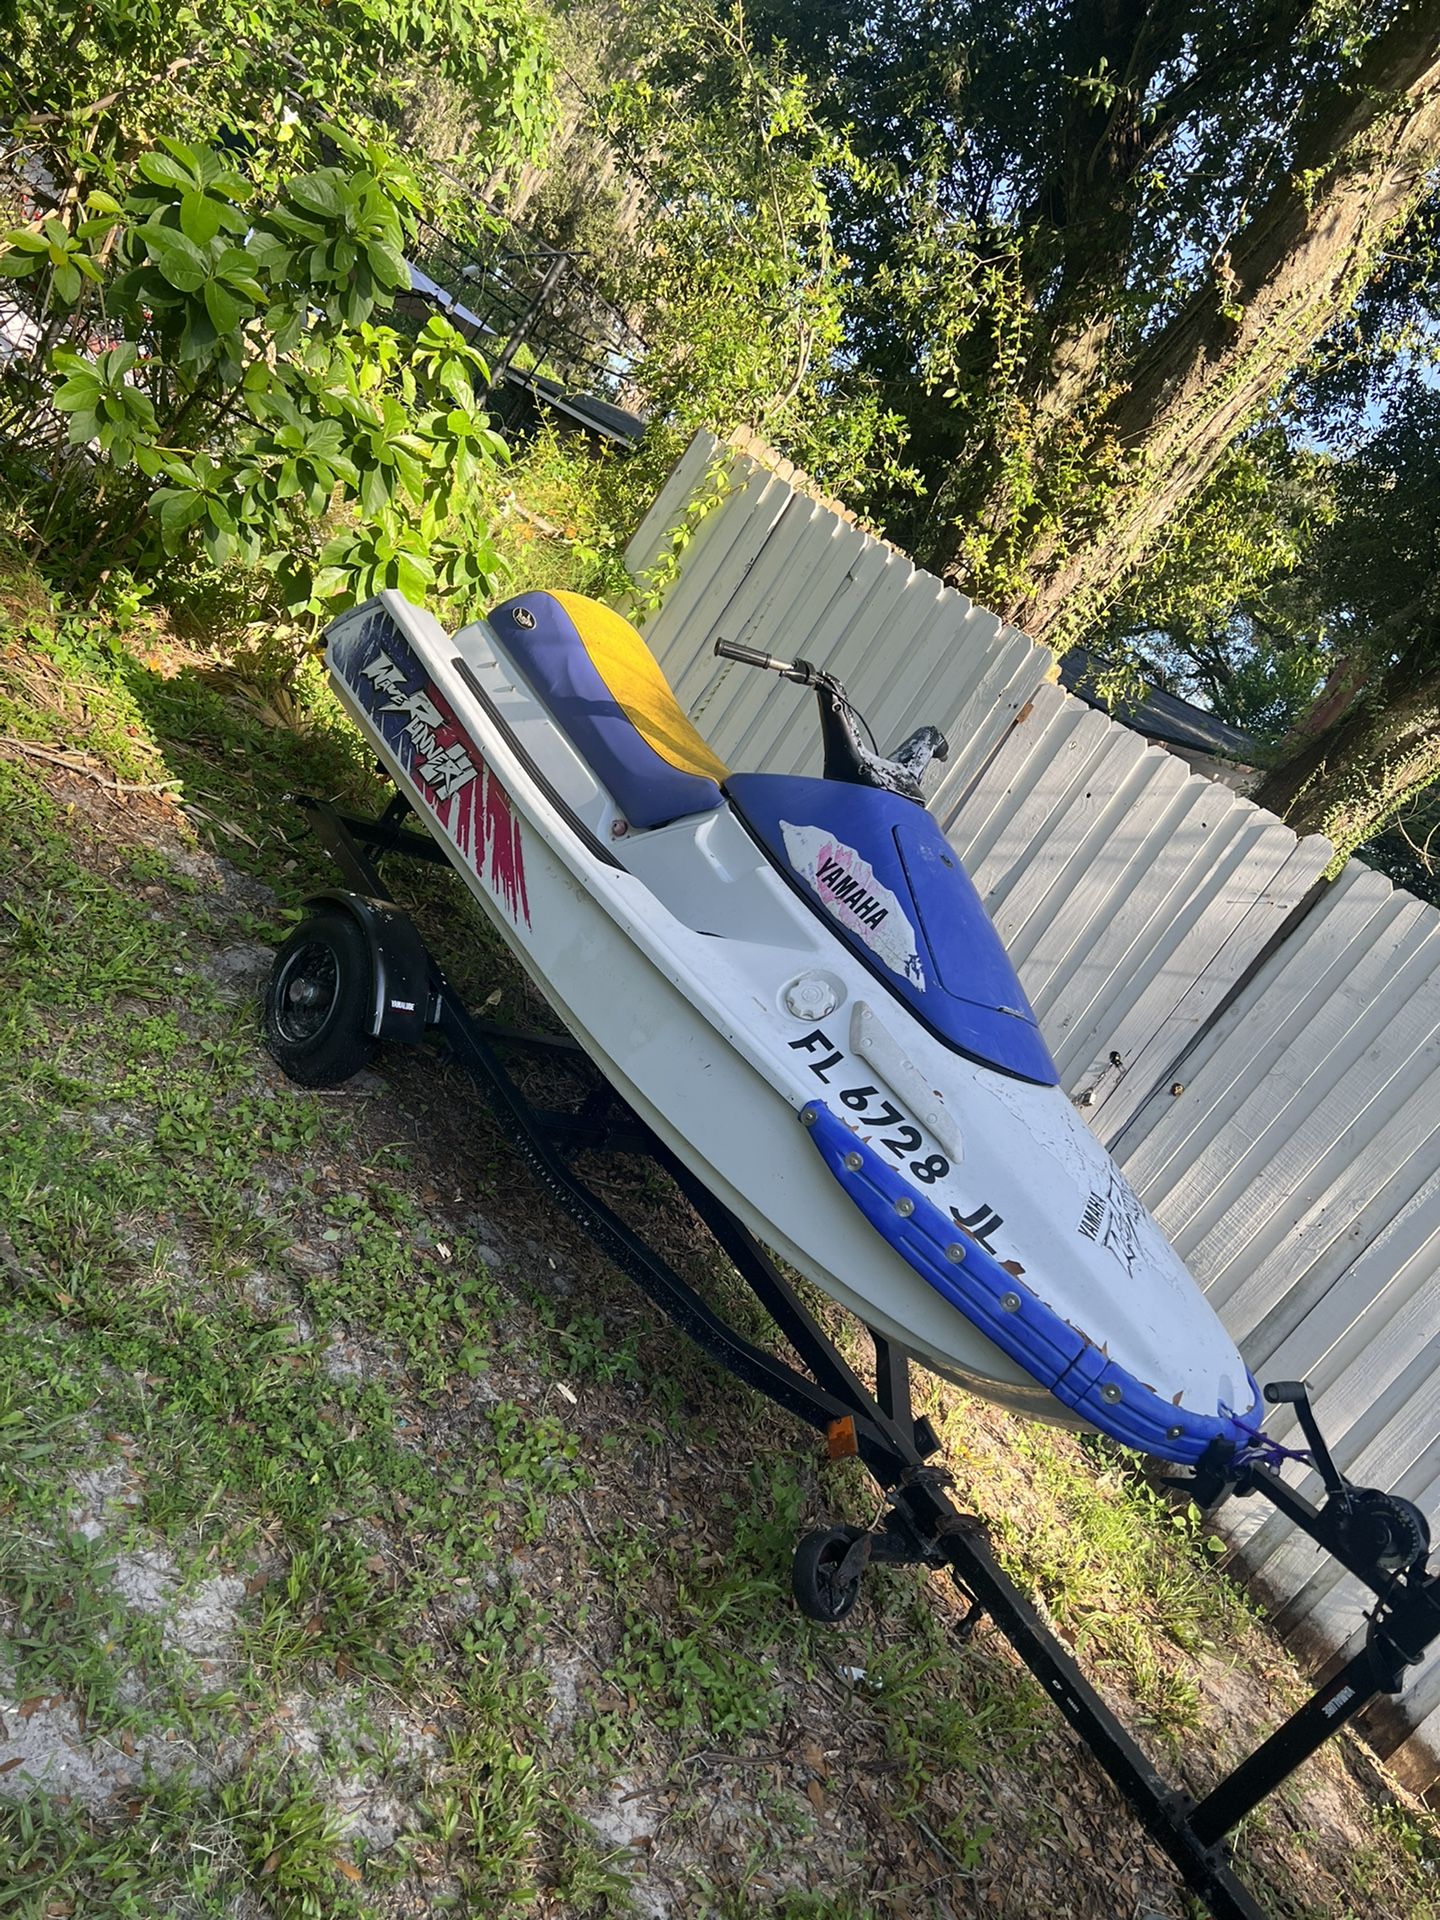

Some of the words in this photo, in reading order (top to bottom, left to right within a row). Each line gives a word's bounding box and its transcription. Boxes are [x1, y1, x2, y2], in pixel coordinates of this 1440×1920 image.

[816, 857, 889, 930] YAMAHA
[788, 1029, 844, 1085] FL
[839, 1086, 950, 1185] 6728
[949, 1203, 1004, 1255] JL
